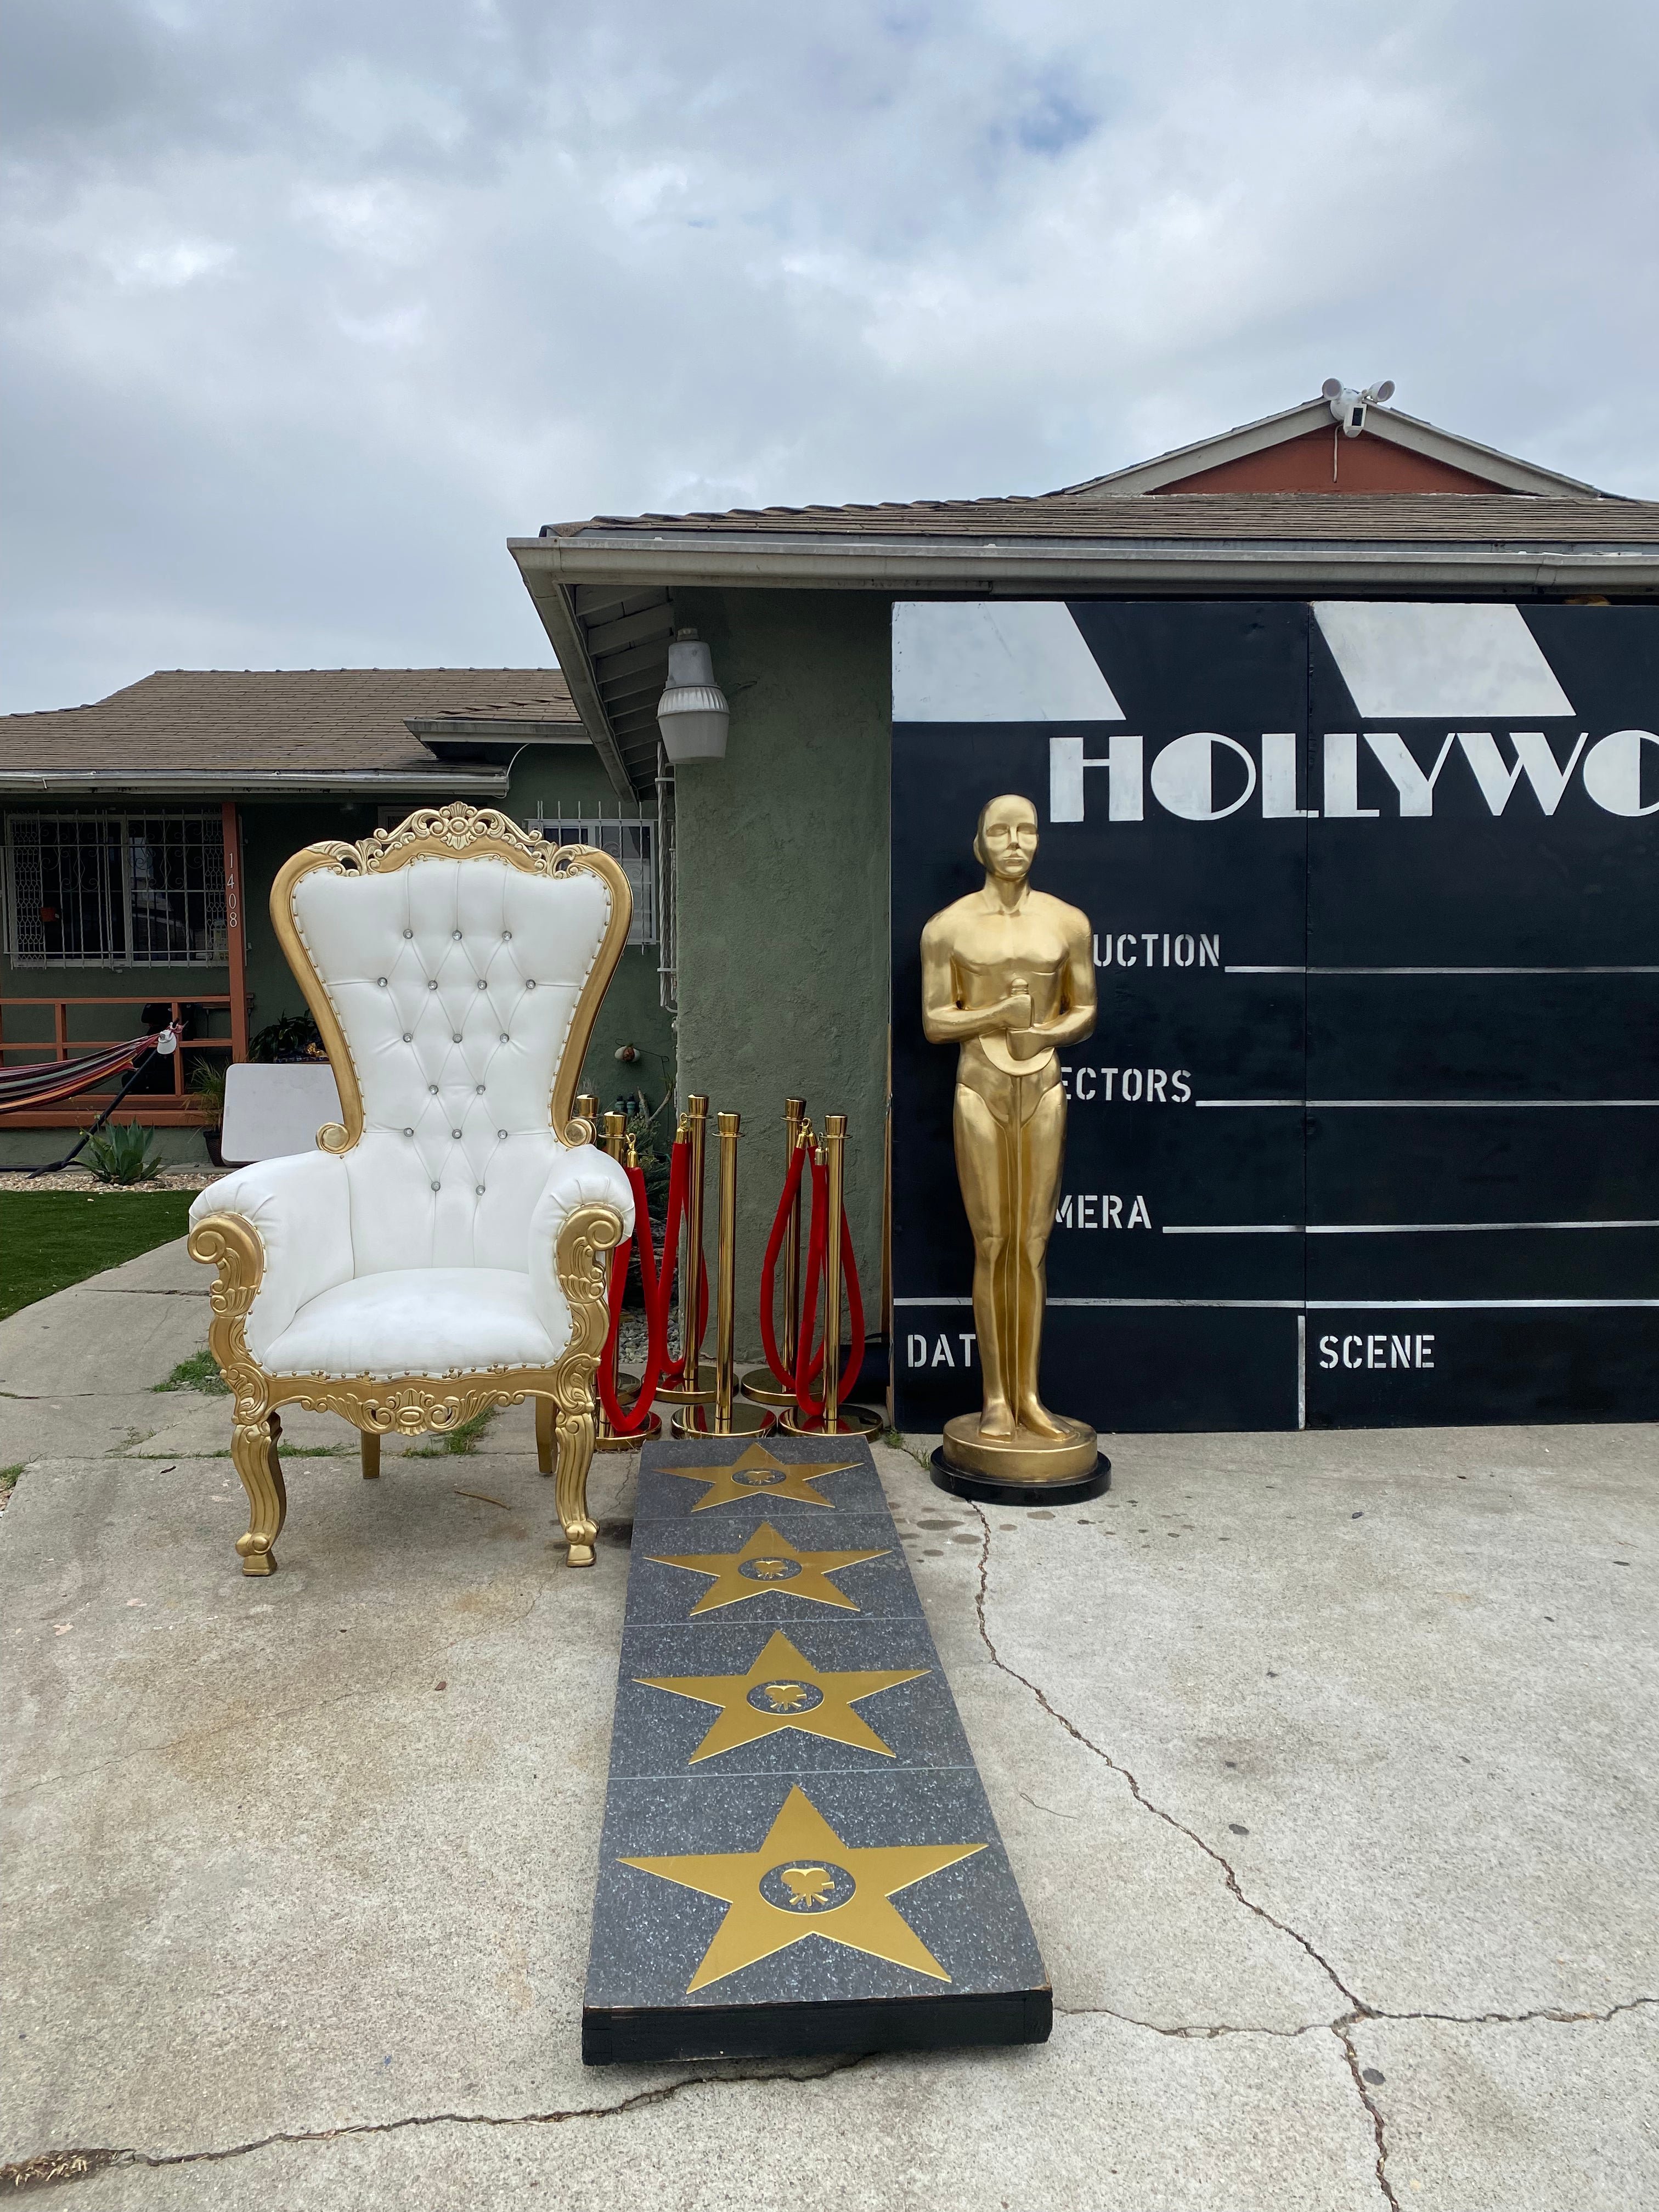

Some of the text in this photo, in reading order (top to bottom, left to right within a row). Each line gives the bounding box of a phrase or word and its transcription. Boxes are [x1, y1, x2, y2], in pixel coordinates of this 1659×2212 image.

[1049, 730, 1659, 822] HOLLYWO
[227, 853, 238, 928] 1408
[1093, 934, 1220, 967] UCTION
[907, 1334, 977, 1367] DAT
[1319, 1335, 1435, 1369] SCENE
